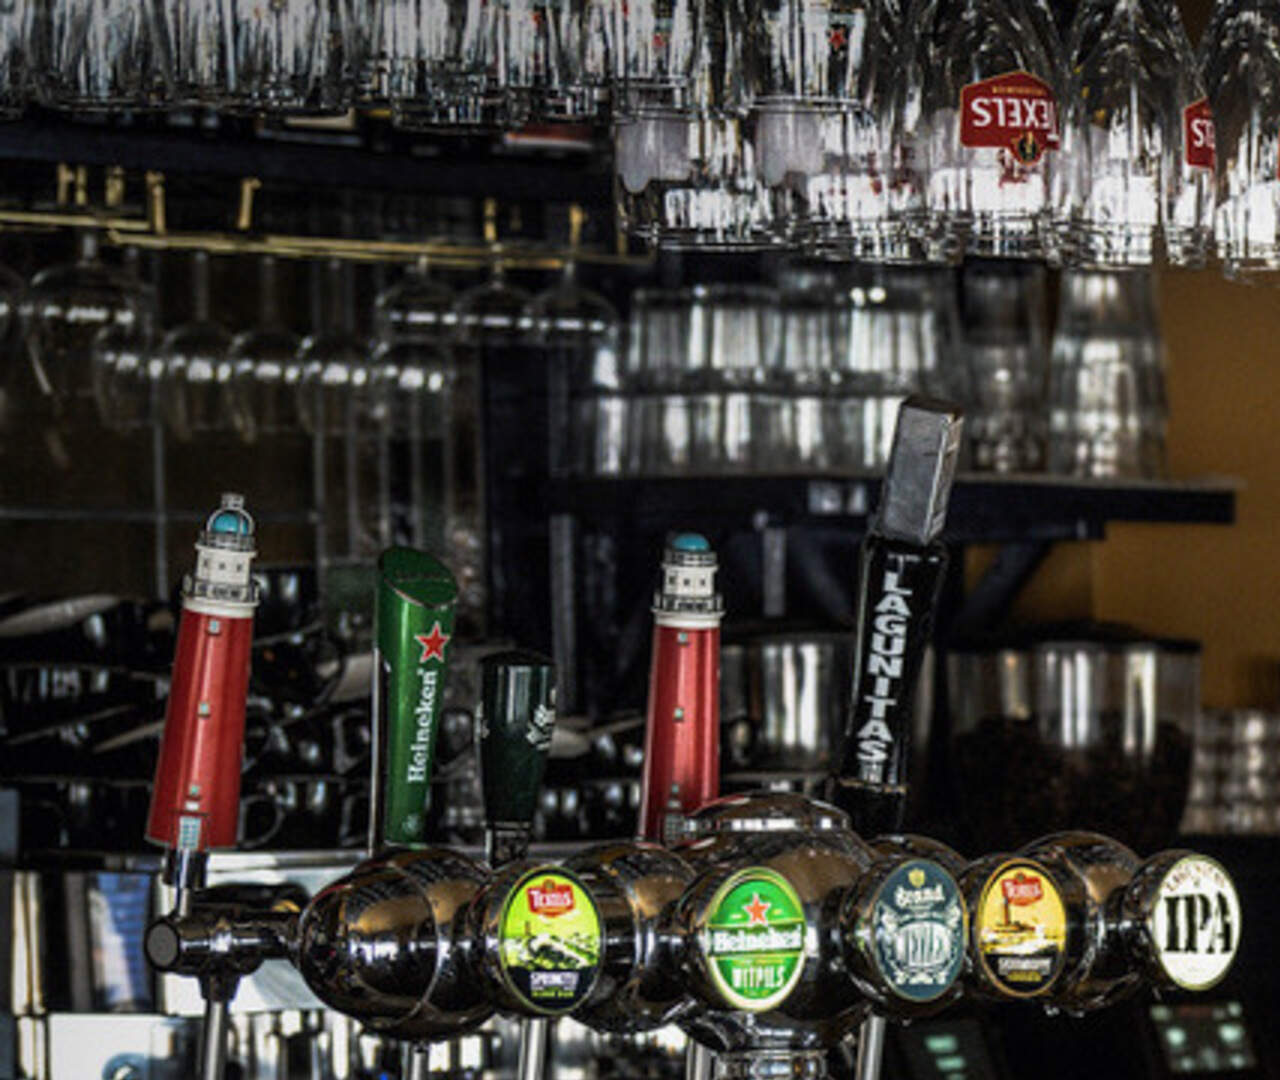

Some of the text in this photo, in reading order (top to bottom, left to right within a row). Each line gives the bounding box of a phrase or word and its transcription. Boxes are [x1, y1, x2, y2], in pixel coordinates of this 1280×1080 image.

[856, 571, 913, 763] LAGUNITAS
[406, 667, 438, 783] Heineken
[712, 925, 802, 953] Heineken
[1163, 891, 1233, 954] IPA
